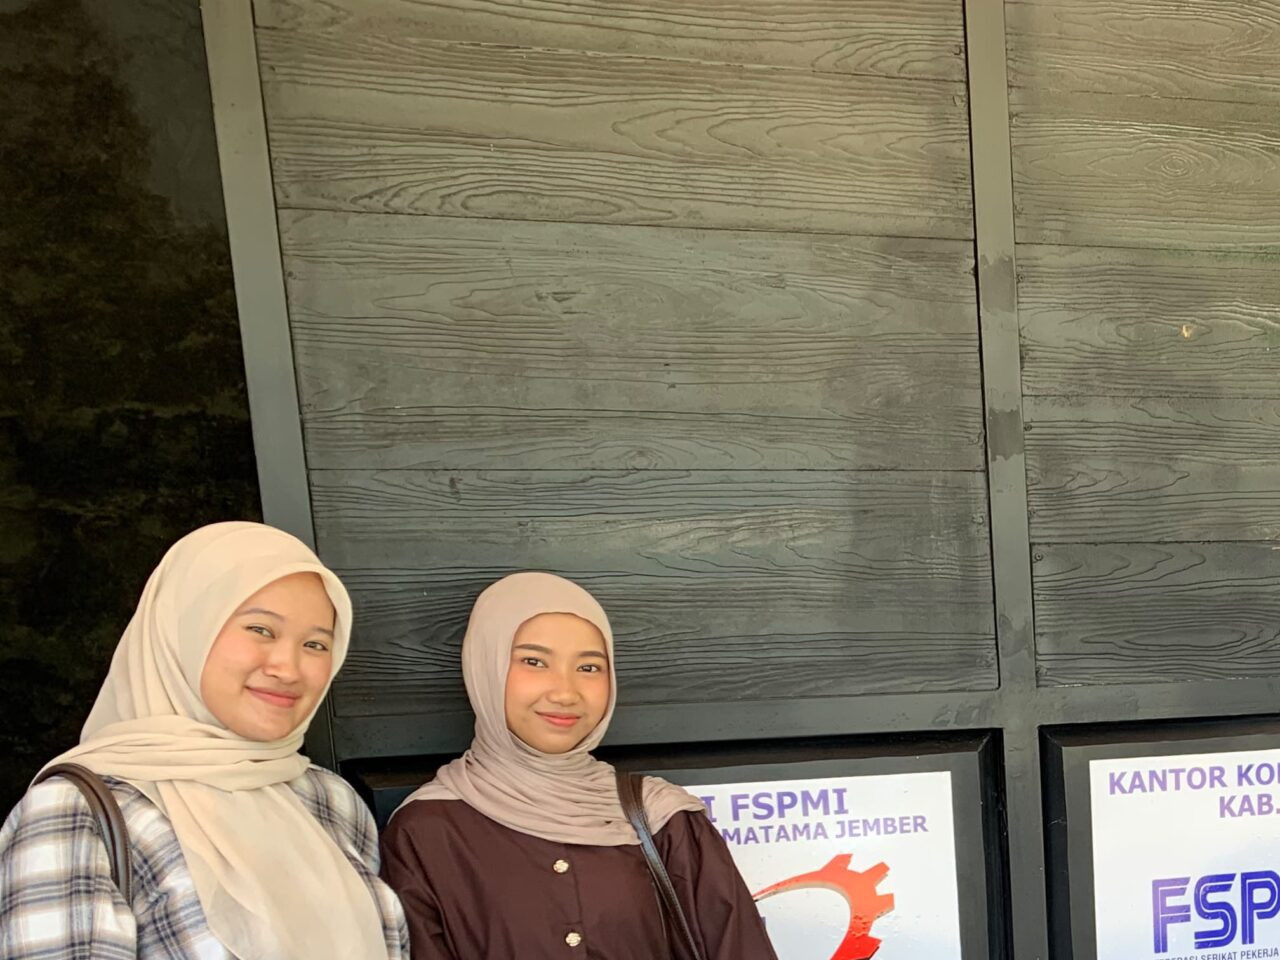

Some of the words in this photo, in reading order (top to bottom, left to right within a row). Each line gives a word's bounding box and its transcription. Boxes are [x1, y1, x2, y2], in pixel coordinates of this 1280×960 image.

[1108, 766, 1228, 795] KANTOR
[730, 788, 849, 822] FSPMI
[835, 815, 929, 839] JEMBER
[1240, 946, 1280, 960] PEKERJA
